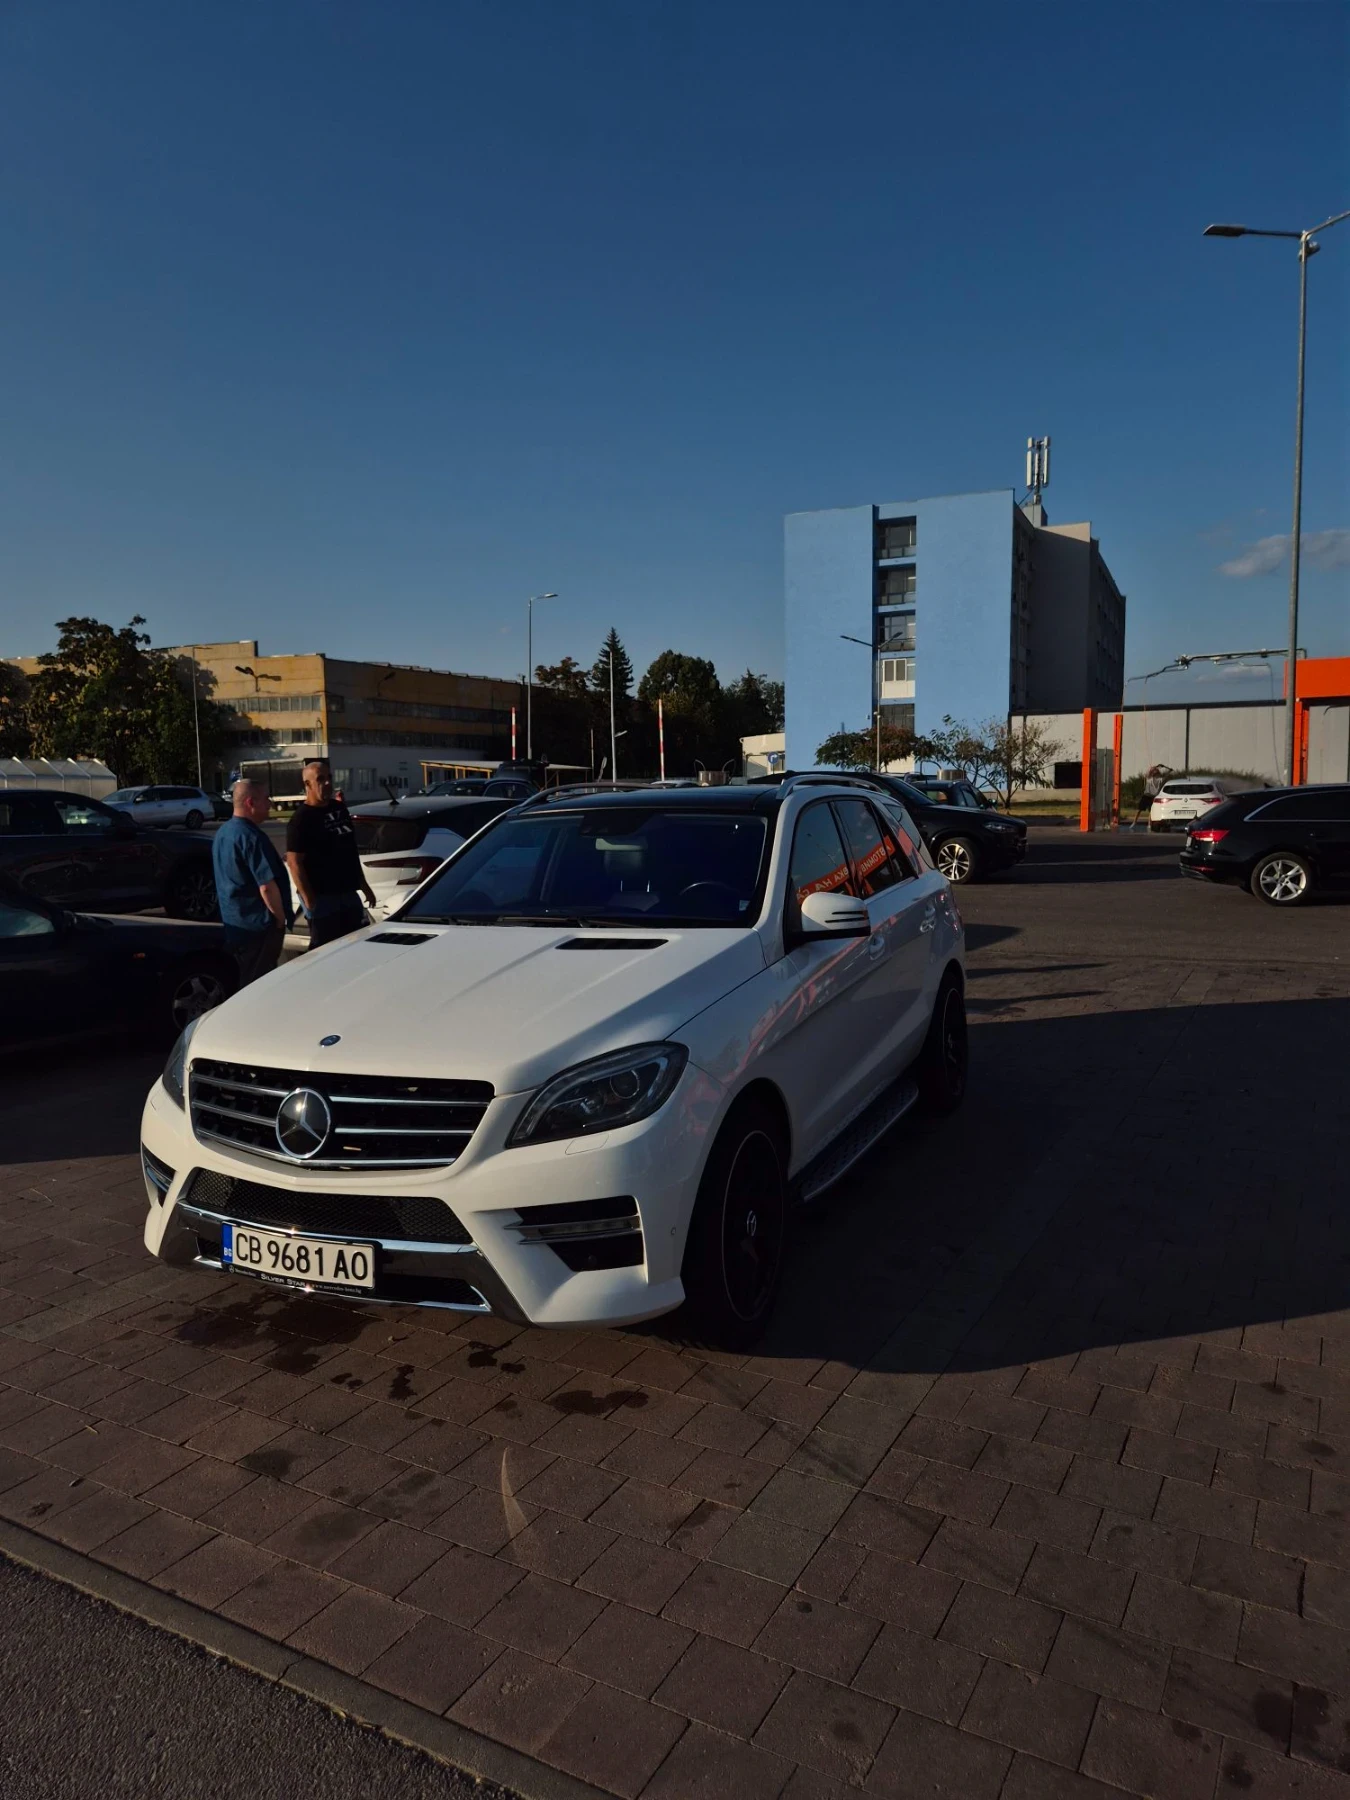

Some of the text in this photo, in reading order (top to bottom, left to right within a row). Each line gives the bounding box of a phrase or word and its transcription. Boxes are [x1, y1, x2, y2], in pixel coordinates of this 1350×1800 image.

[223, 1247, 233, 1258] BG
[235, 1232, 263, 1264] CB
[267, 1240, 325, 1277] 9681
[286, 1277, 306, 1288] STAR
